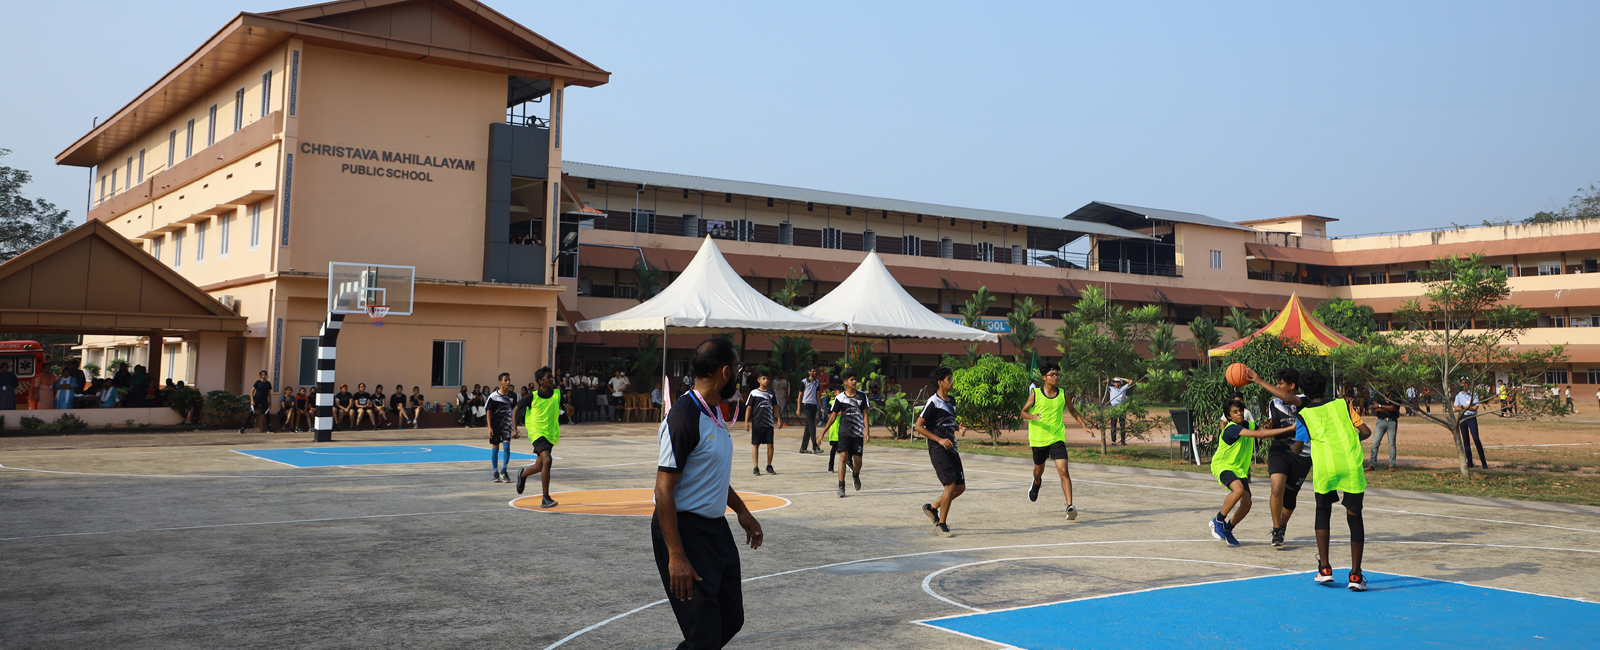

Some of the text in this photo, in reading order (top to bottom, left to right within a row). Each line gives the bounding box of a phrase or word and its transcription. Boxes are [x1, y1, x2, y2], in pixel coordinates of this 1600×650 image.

[301, 142, 475, 171] CHRISTAVA MAHILALAYAM
[341, 163, 433, 182] PUBLIC SCHOOL
